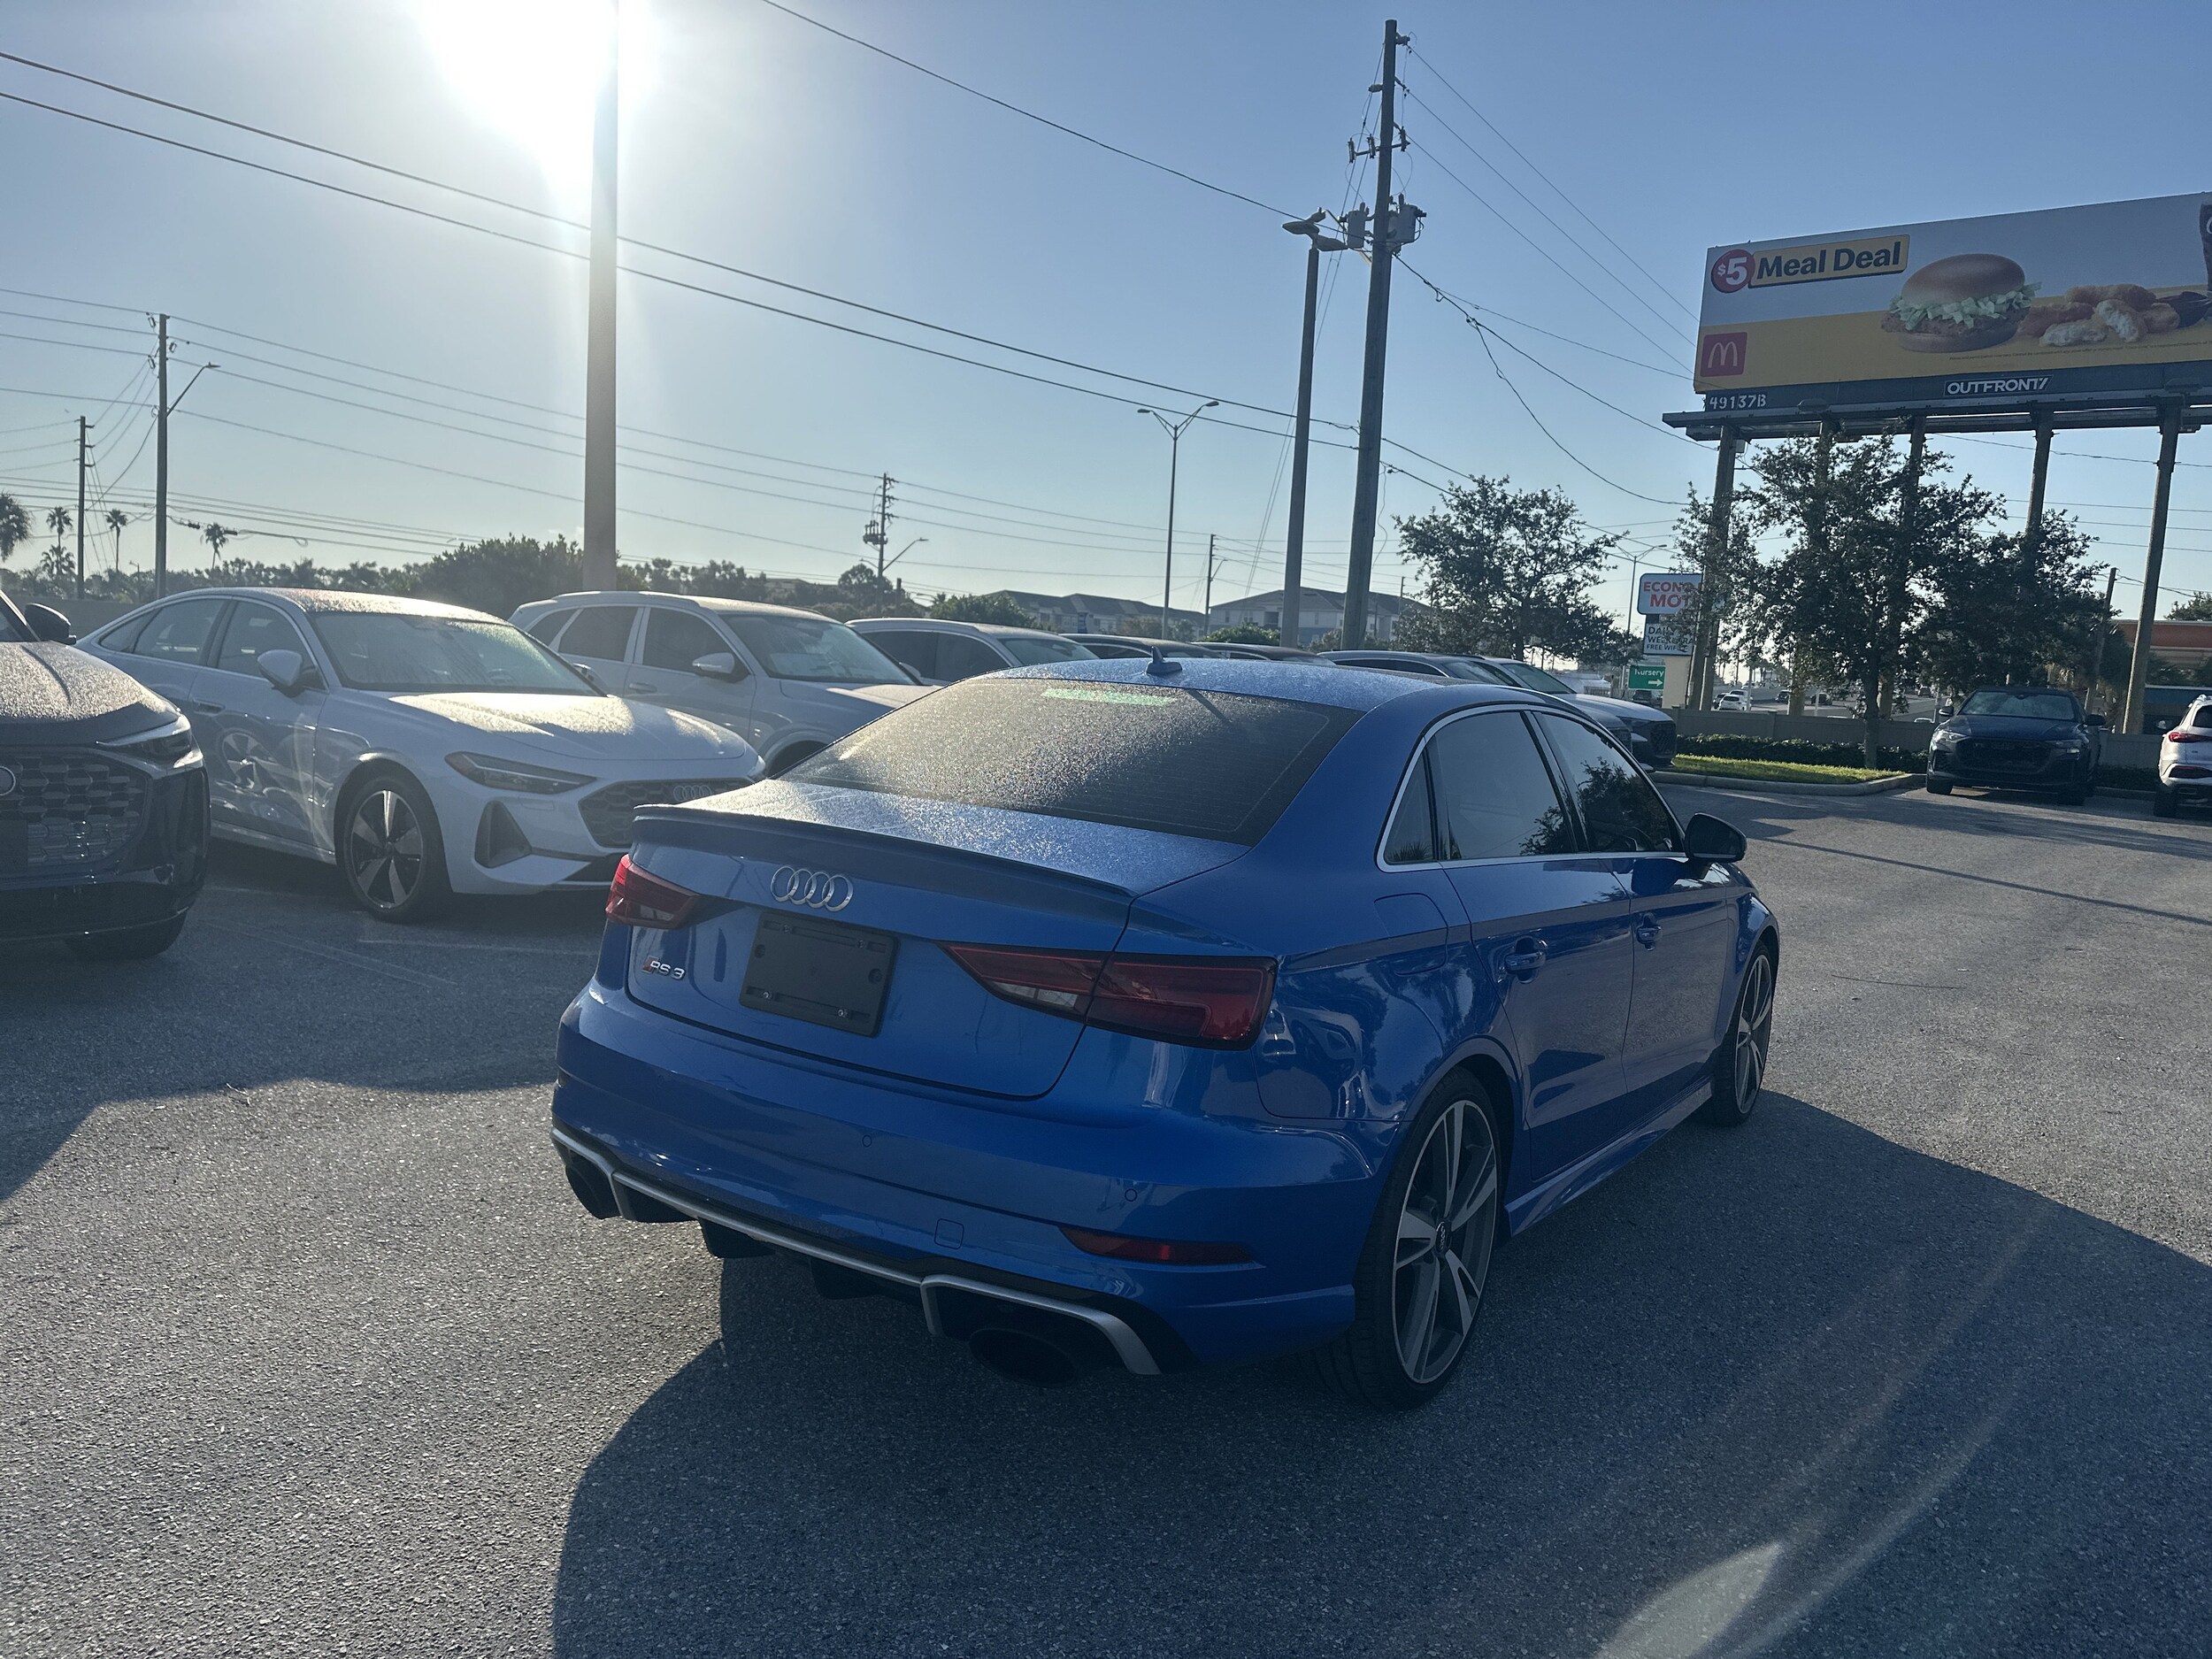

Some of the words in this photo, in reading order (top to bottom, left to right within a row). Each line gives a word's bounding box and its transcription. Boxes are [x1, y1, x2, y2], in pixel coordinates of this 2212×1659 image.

[1717, 256, 1747, 286] $5
[1756, 249, 1827, 280] Meal
[1832, 241, 1901, 272] Deal
[1709, 394, 1767, 410] 49137B
[1649, 594, 1693, 609] MOT
[1634, 668, 1664, 678] Nursery
